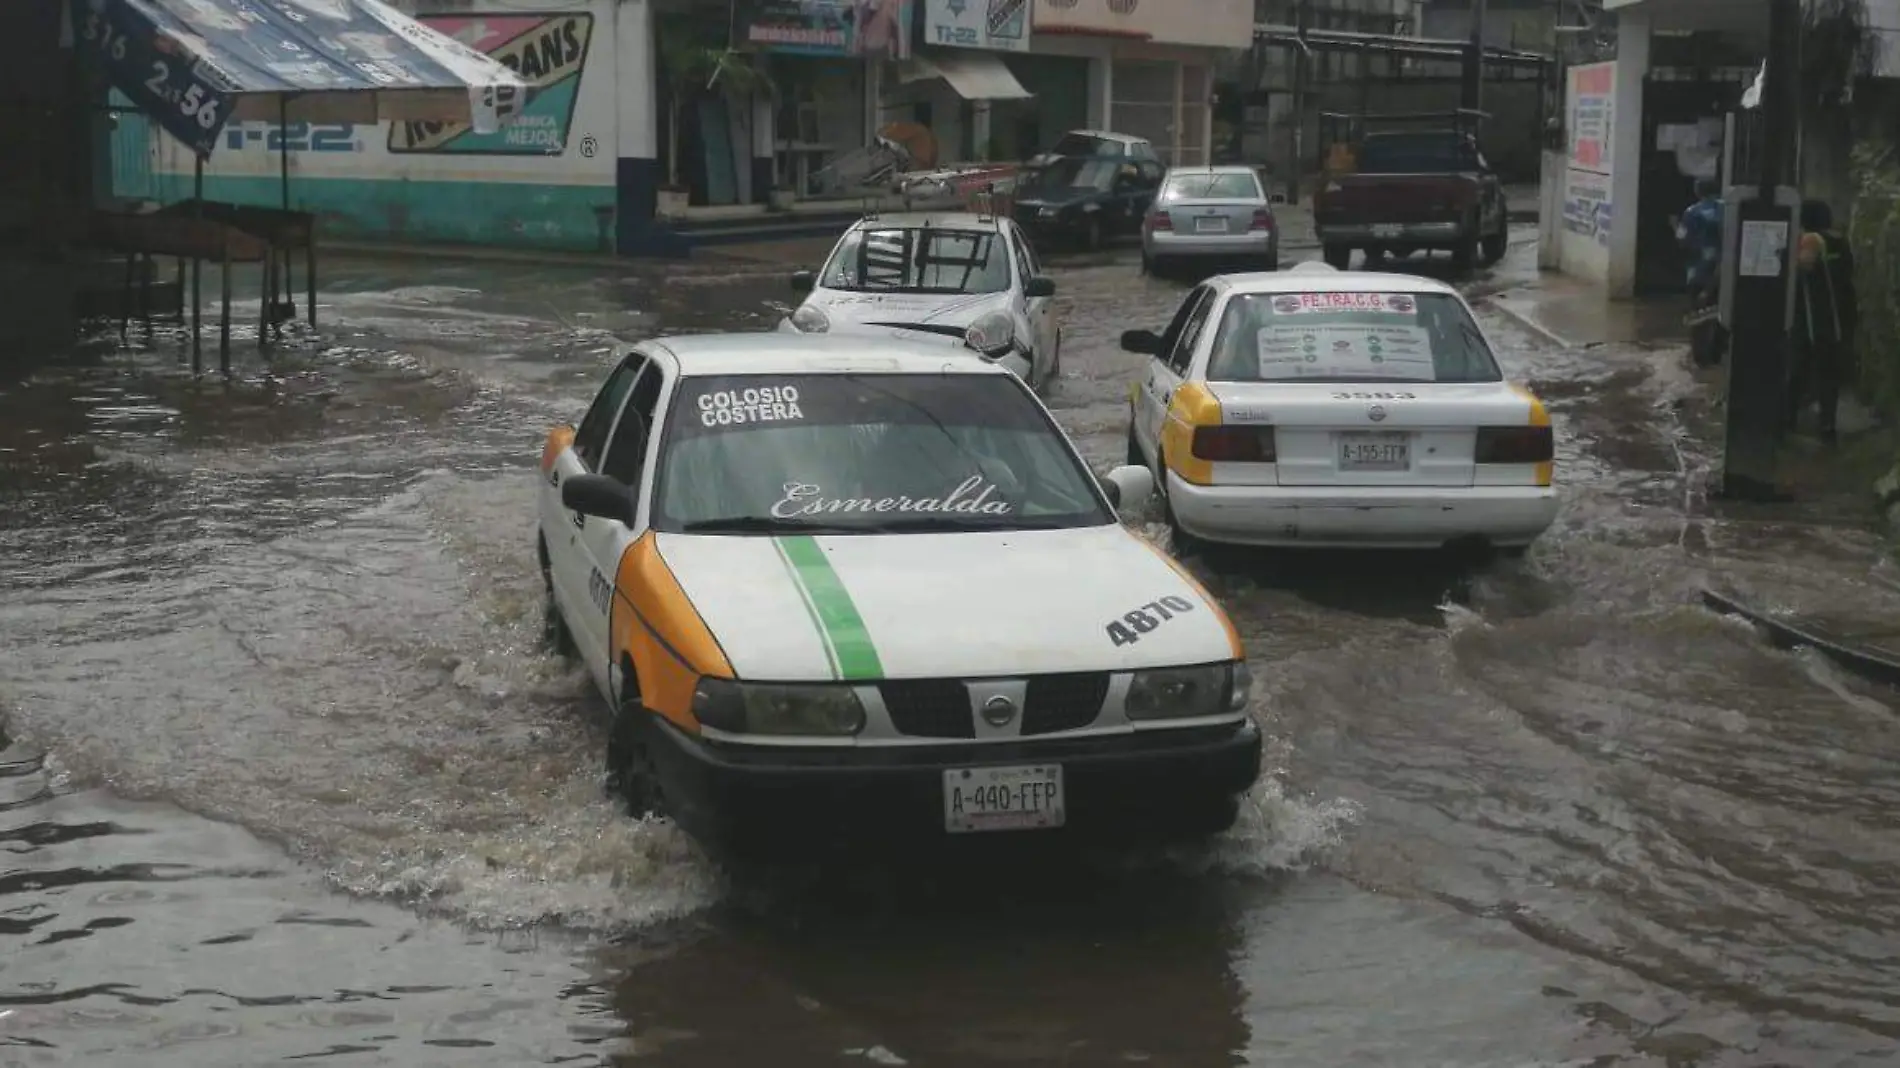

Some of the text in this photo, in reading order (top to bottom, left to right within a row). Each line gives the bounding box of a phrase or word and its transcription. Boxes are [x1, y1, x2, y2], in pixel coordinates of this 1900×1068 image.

[698, 386, 798, 411] COLOSIO
[702, 402, 804, 427] COSTERA
[771, 475, 1013, 519] Esmeralda
[1106, 596, 1195, 647] 4870
[952, 781, 1056, 812] A-440-FFP
